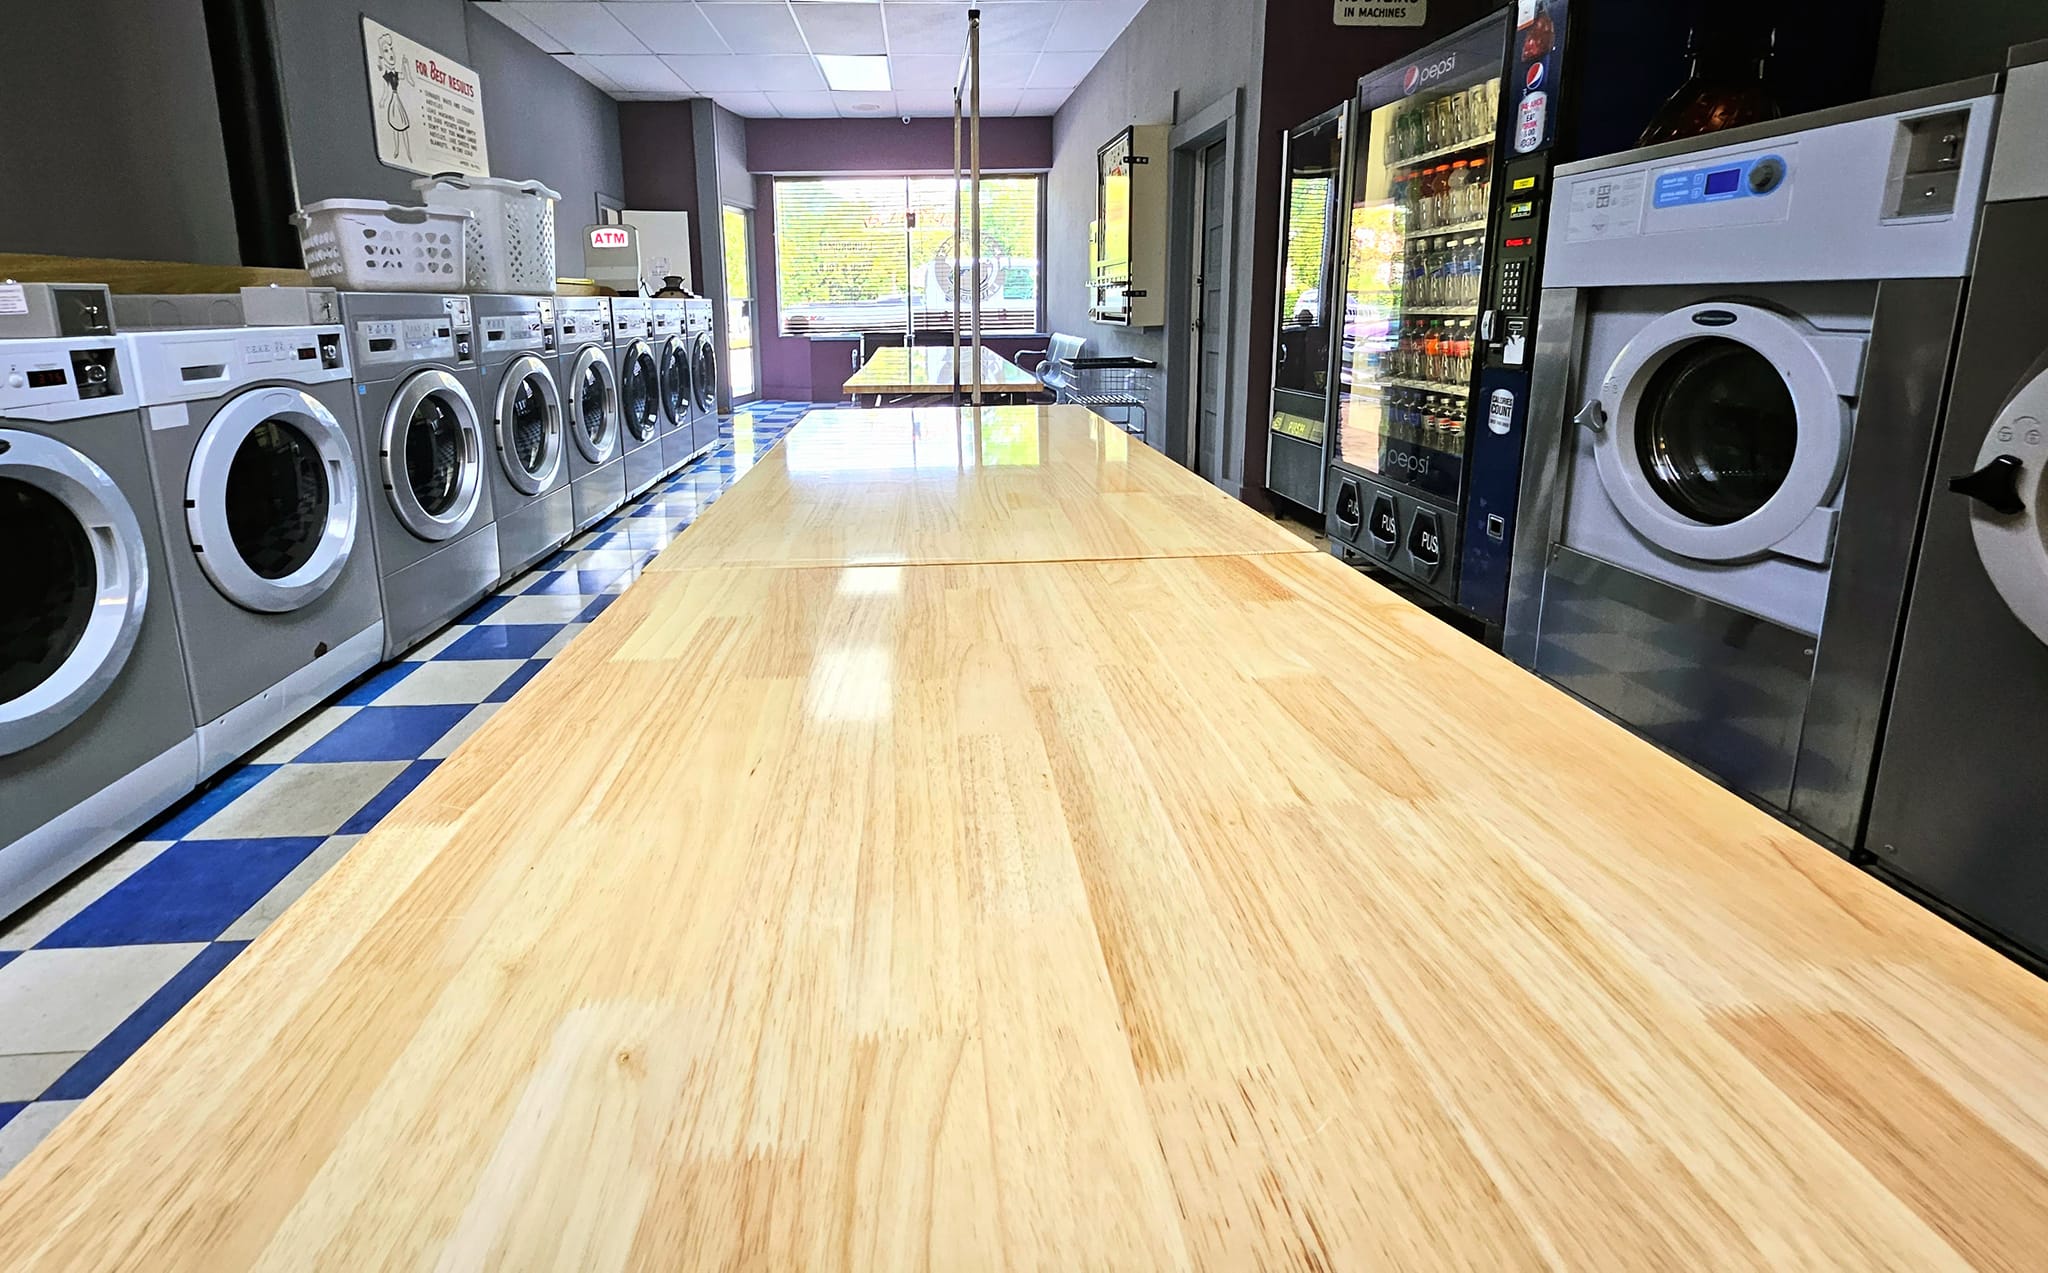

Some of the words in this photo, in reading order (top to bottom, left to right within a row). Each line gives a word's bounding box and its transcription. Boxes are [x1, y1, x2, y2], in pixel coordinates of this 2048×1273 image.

[1344, 7, 1354, 17] IN
[1359, 7, 1406, 18] MACHINES
[415, 59, 429, 78] FOR
[448, 74, 475, 98] RESULTS
[1419, 52, 1457, 86] pepsi
[594, 232, 625, 244] ATM
[1490, 403, 1512, 417] COUNT
[1387, 448, 1430, 475] pepsi
[1347, 498, 1359, 517] PUS
[1381, 514, 1396, 534] PUS
[1421, 531, 1439, 555] PUS
